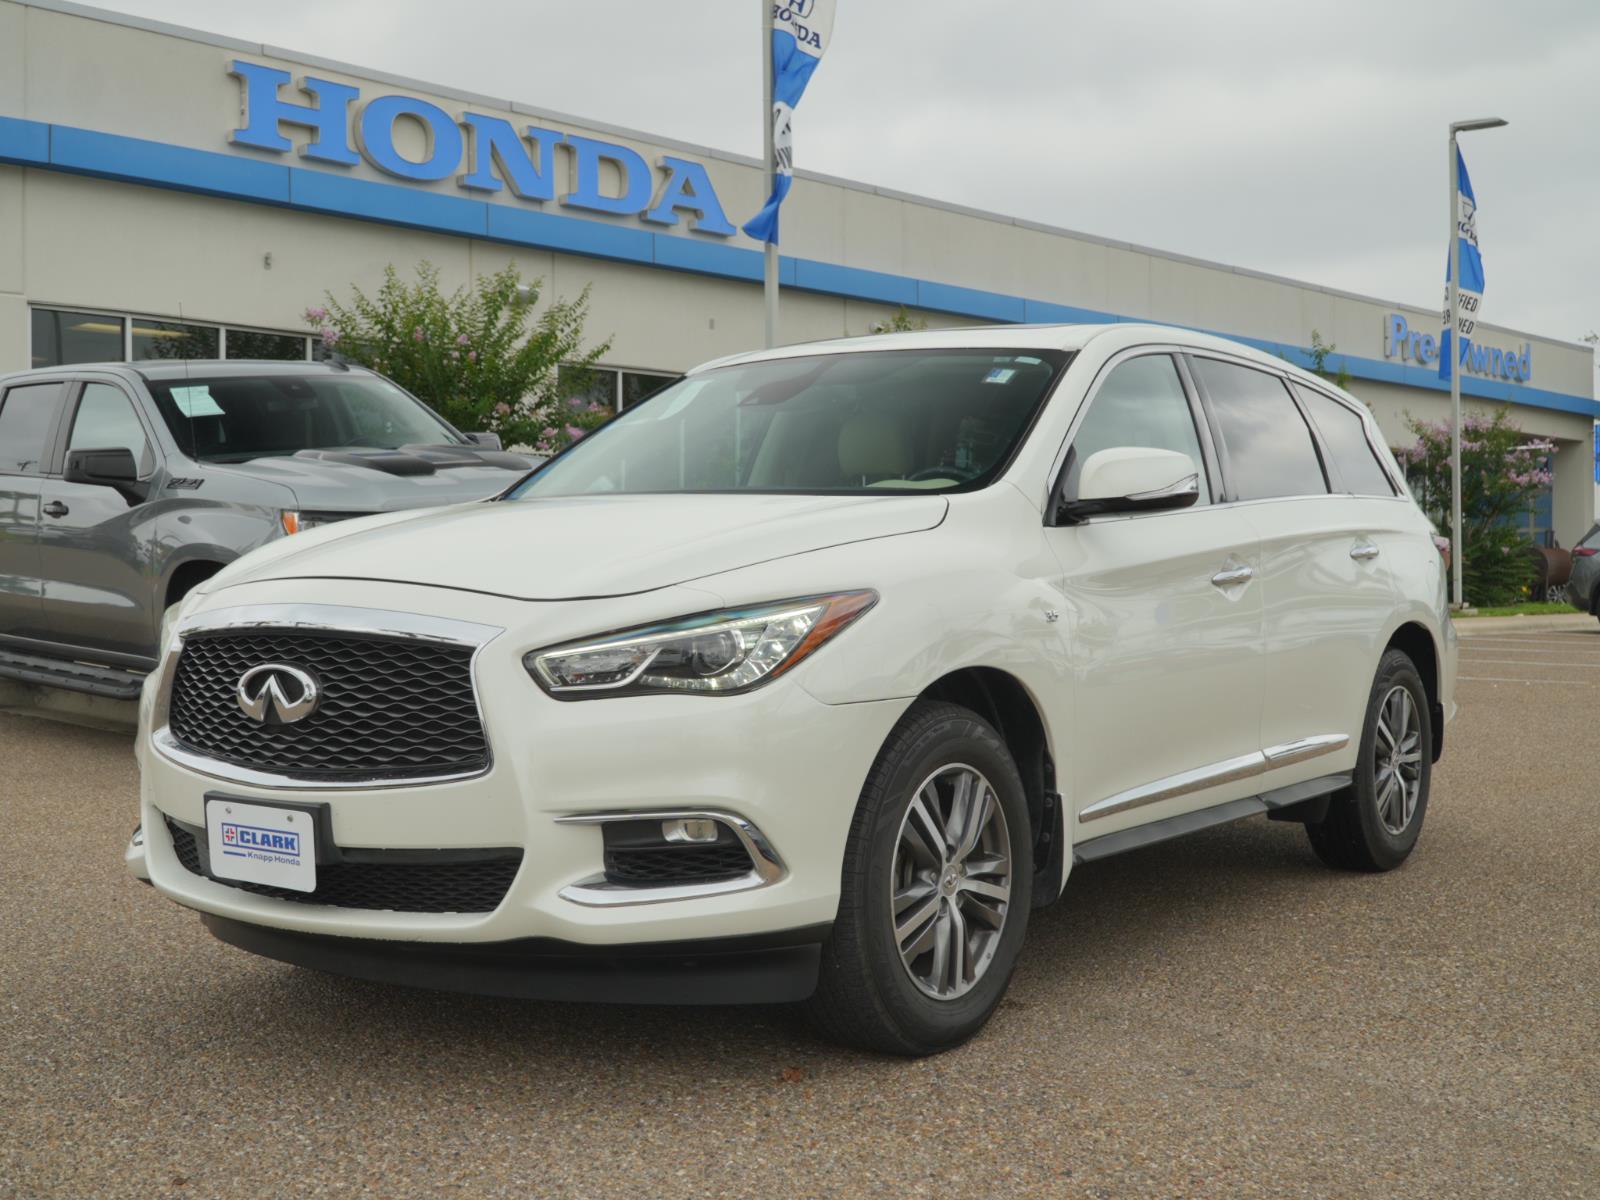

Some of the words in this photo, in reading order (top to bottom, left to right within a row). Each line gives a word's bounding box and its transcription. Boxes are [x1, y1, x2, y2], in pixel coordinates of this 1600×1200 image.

[229, 59, 737, 237] HONDA
[239, 830, 296, 851] CLARK
[247, 851, 273, 863] Knapp
[274, 855, 300, 866] Honda
